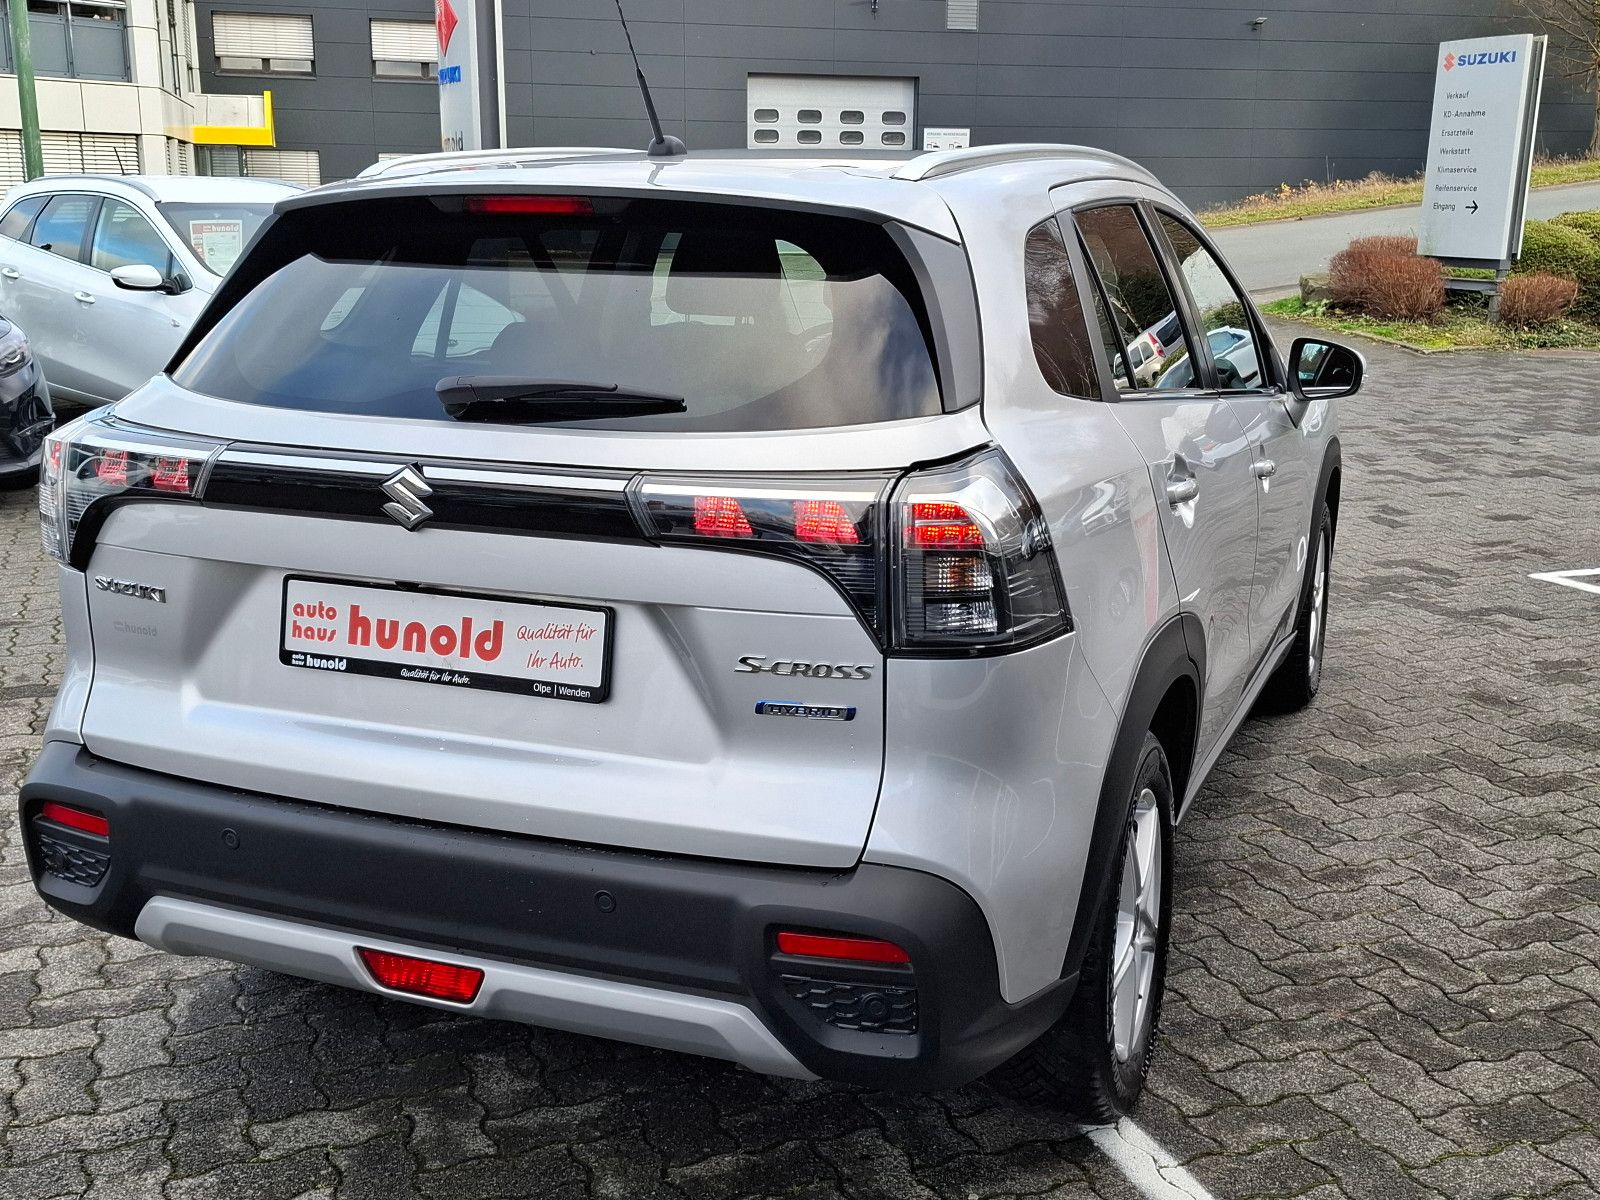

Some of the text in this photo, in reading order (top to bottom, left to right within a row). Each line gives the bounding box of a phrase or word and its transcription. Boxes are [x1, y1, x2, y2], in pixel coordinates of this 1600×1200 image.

[1457, 50, 1517, 67] SUZUKI
[1446, 90, 1470, 100] Verkauf
[1443, 109, 1486, 119] KD-Annahme
[1441, 128, 1474, 137] Ersatzteile
[1439, 147, 1470, 155] Werkstatt
[1437, 165, 1477, 174] Klimaservice
[1434, 184, 1478, 192] Reifenservice
[1432, 201, 1456, 212] Eingang
[95, 575, 167, 604] SUZUKI
[292, 600, 338, 621] auto
[291, 619, 337, 643] haus
[347, 603, 504, 662] hunold
[516, 622, 598, 644] Qualität für
[306, 654, 347, 671] hunold
[526, 649, 584, 670] Ihr Auto.
[734, 654, 875, 680] S-CROSS
[400, 668, 471, 685] Qualität für Ihr Auto.
[533, 682, 552, 694] Olpe
[558, 685, 591, 699] Wenden
[770, 704, 842, 719] HYBRID
